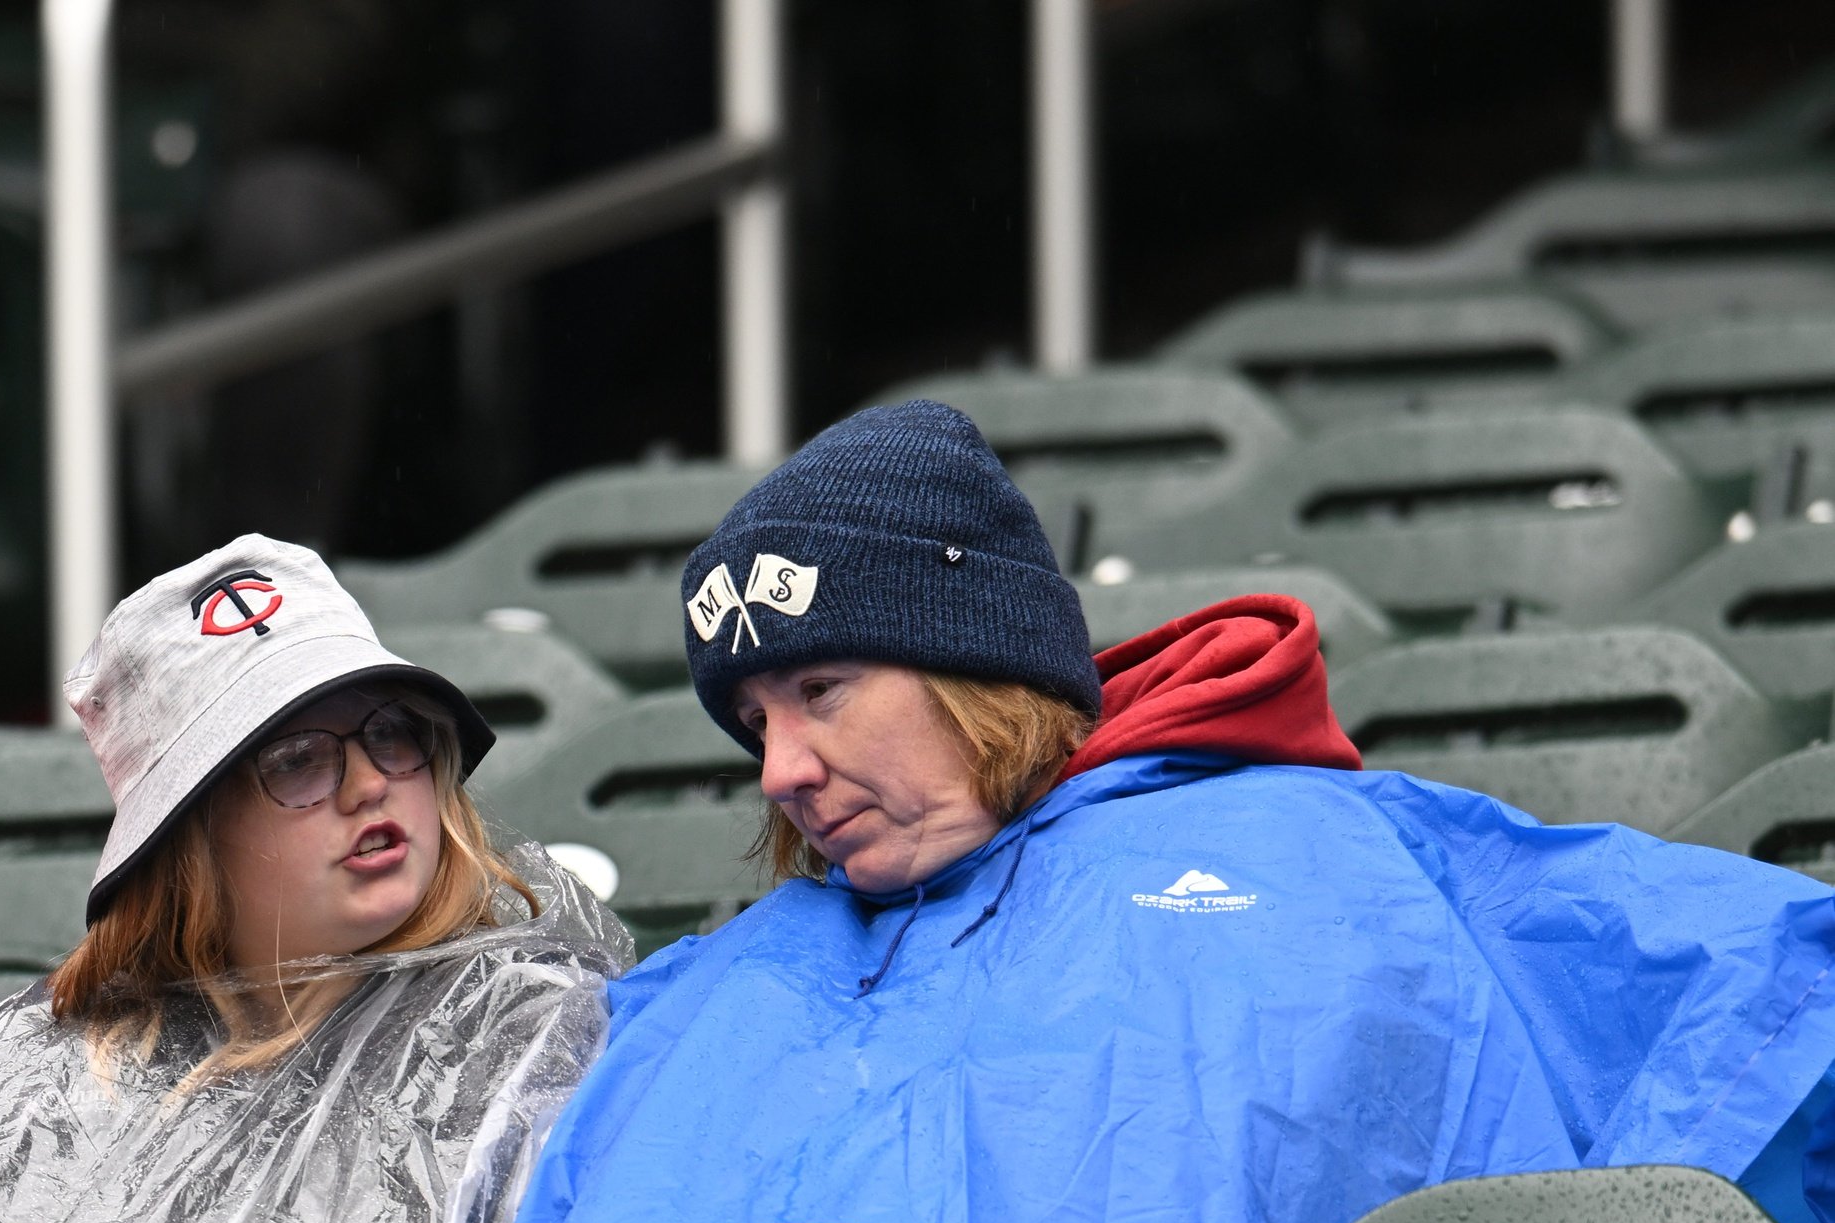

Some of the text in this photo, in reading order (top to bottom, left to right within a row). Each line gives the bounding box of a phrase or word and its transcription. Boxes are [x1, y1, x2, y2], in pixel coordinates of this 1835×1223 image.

[697, 584, 722, 628] M
[1132, 894, 1198, 907] OZARK
[1189, 904, 1249, 913] EQUIPMENT
